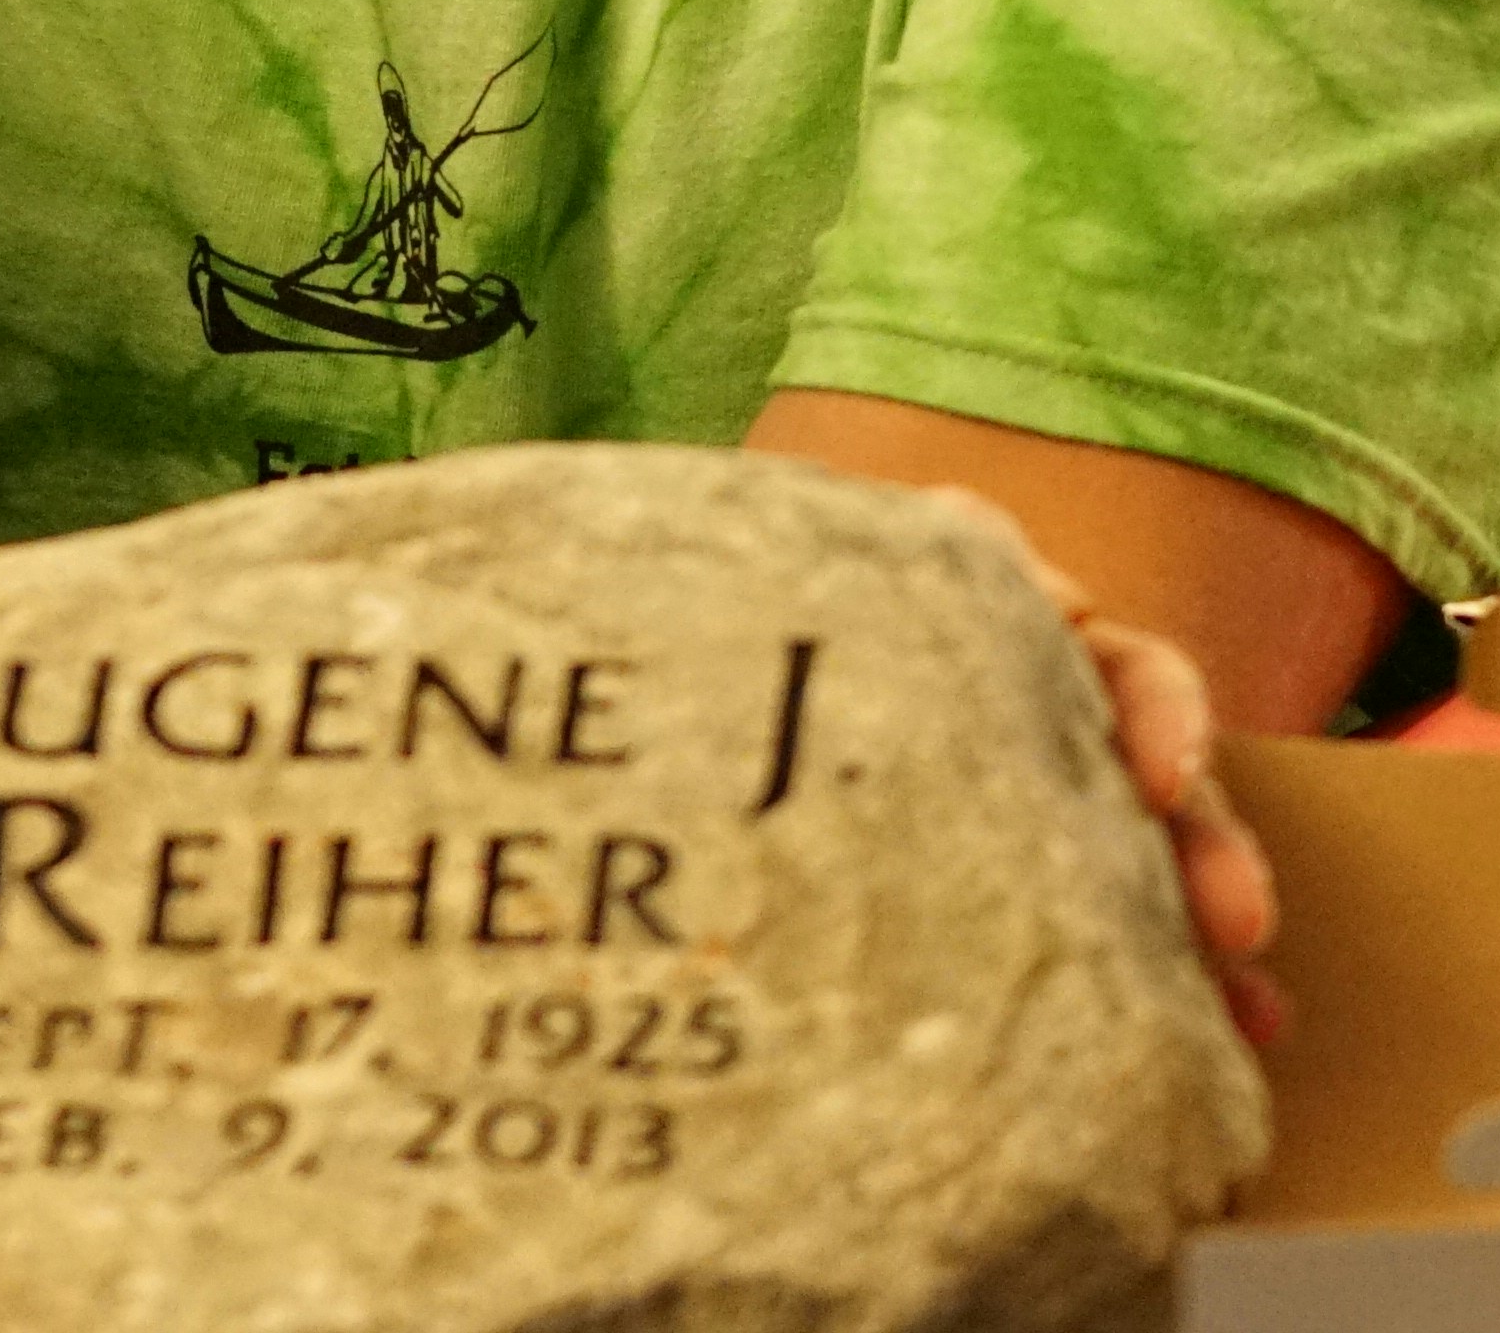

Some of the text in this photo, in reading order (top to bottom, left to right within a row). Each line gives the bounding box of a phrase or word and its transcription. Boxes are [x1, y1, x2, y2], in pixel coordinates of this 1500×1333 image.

[748, 635, 866, 819] J.
[476, 993, 743, 1079] 1925
[395, 1093, 678, 1179] 2013
